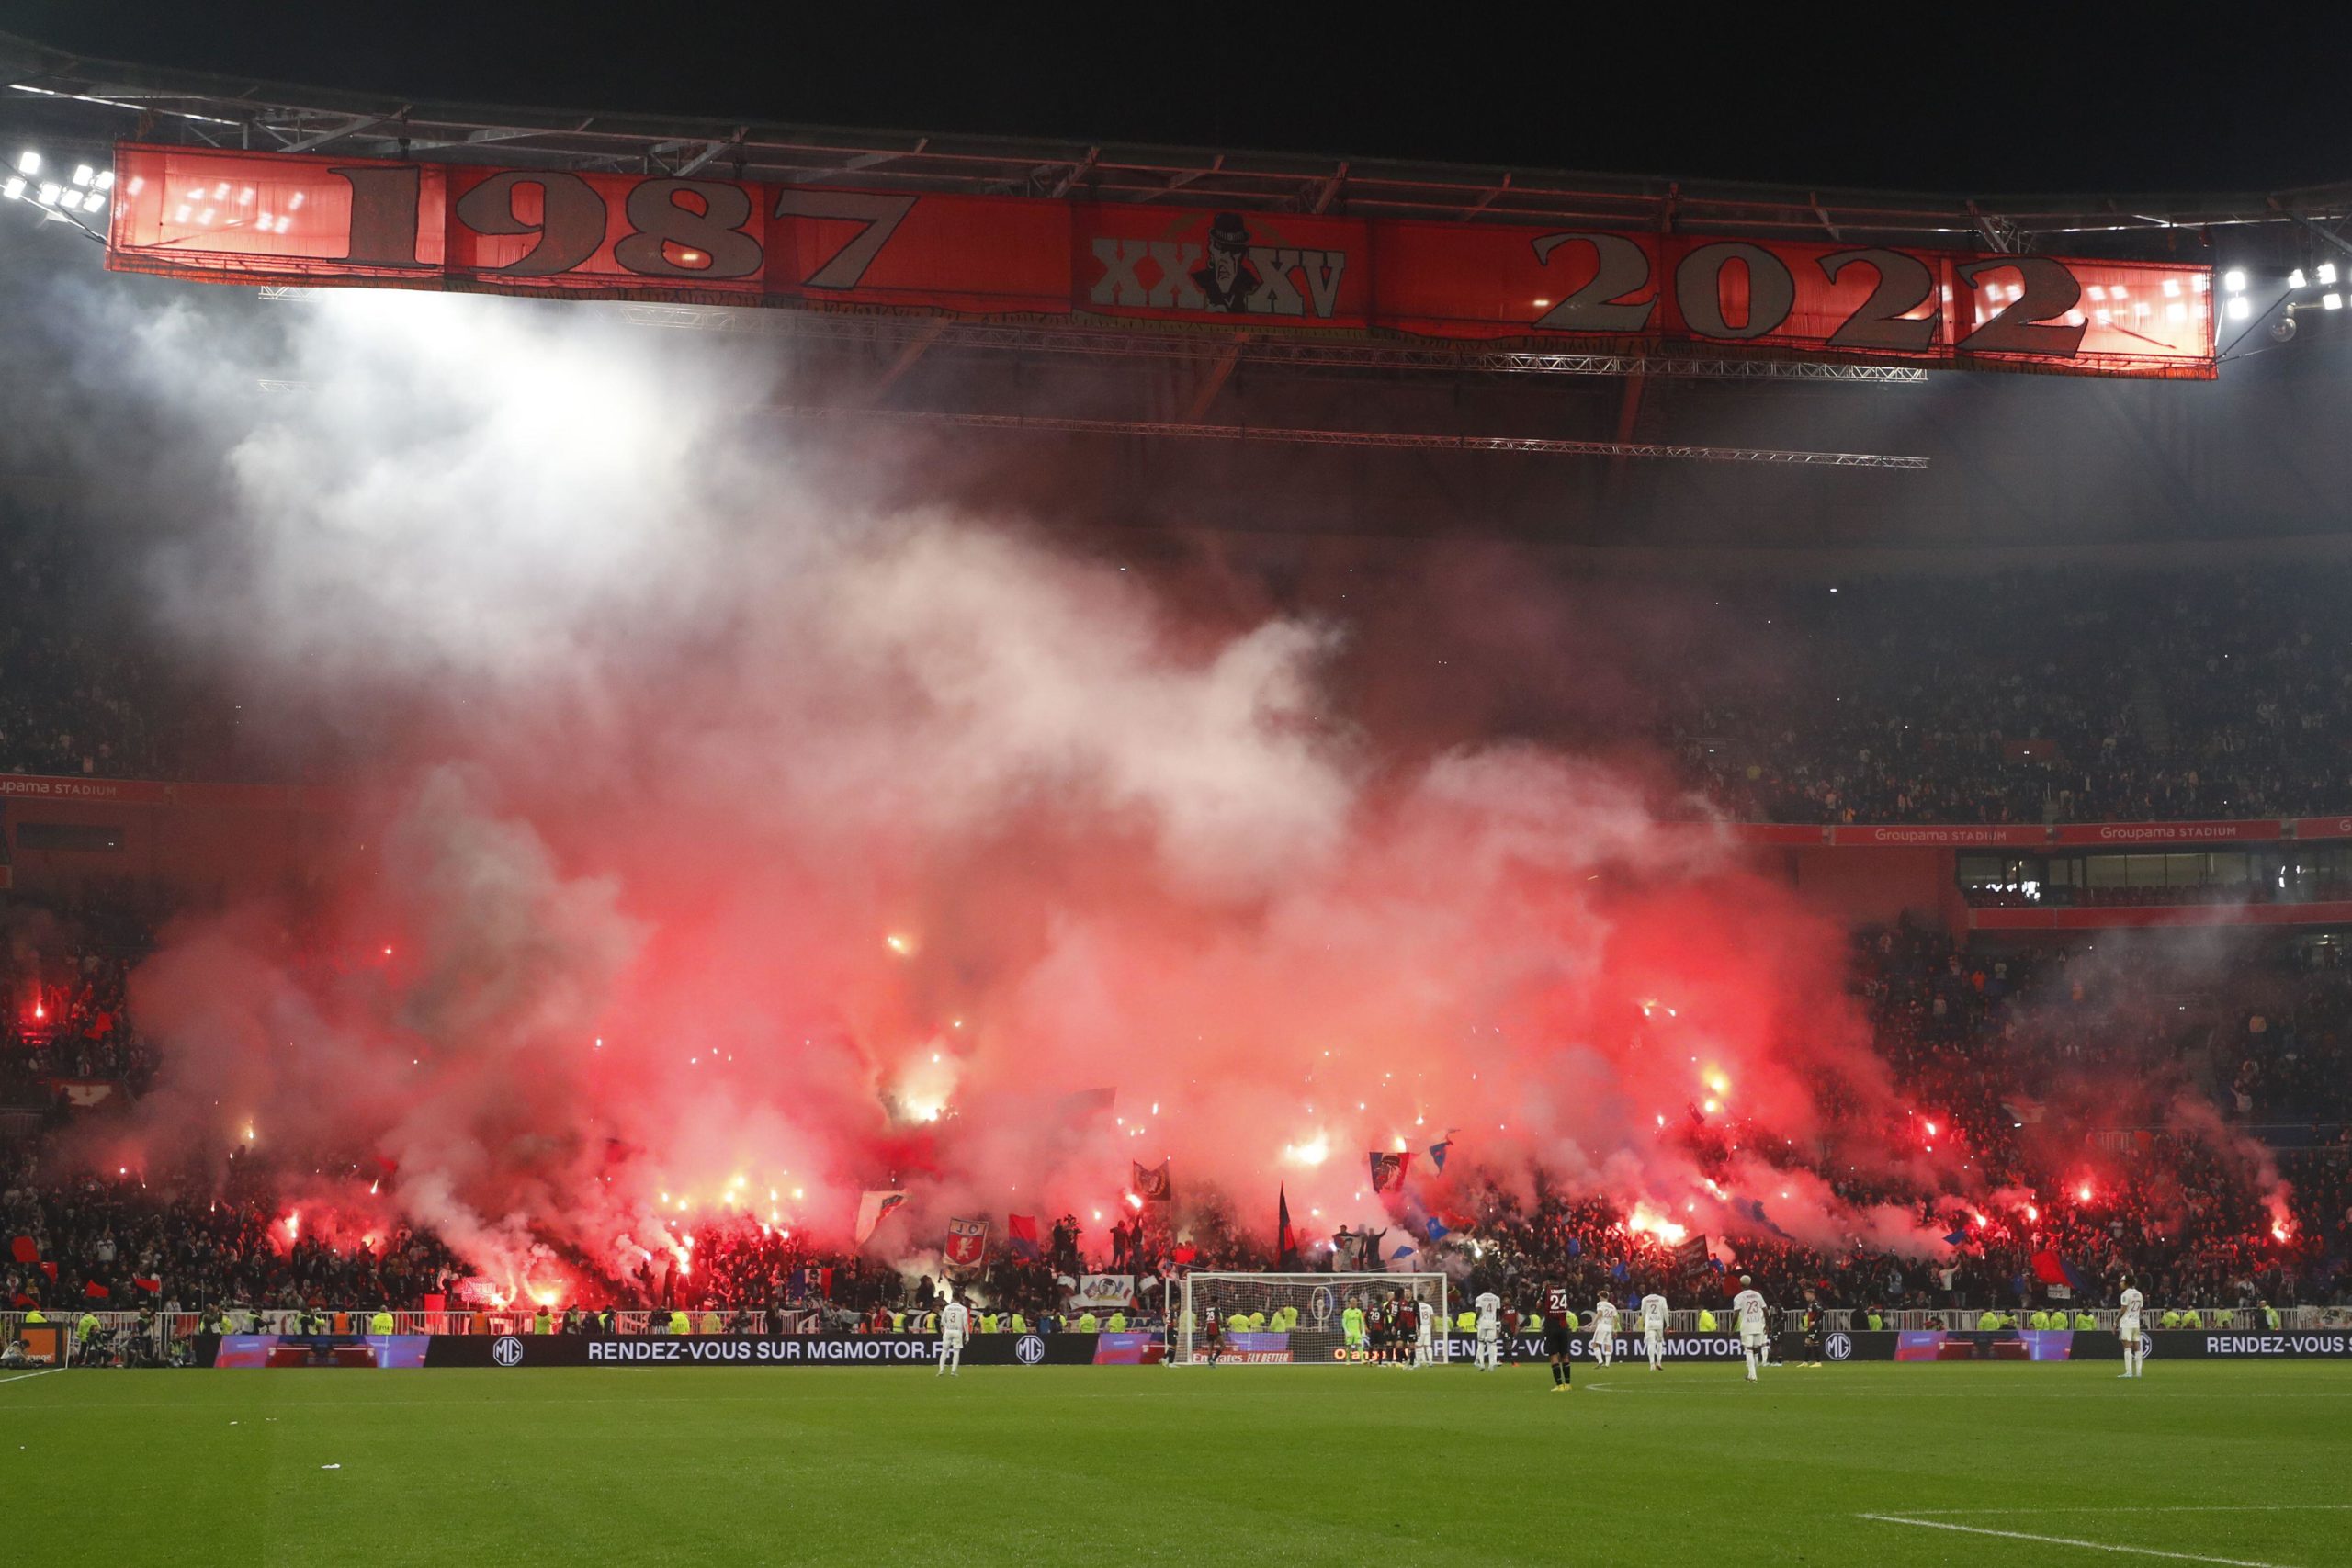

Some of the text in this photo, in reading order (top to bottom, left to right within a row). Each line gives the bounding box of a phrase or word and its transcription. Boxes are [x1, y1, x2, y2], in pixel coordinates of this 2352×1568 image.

[328, 166, 917, 290] 1987
[1530, 232, 2088, 359] 2022
[55, 784, 117, 796] STADIUM
[1875, 829, 2007, 842] Groupama STADIUM
[2101, 827, 2236, 840] Groupama STADIUM
[1486, 1303, 1492, 1313] 4
[1549, 1293, 1567, 1310] 24
[1746, 1300, 1758, 1314] 23
[2131, 1300, 2141, 1312] 27
[1650, 1303, 1657, 1314] 2
[949, 1312, 956, 1323] 3
[1370, 1311, 1380, 1321] 29
[495, 1340, 521, 1362] MG
[588, 1341, 751, 1359] RENDEZ-VOUS
[756, 1341, 801, 1359] SUR
[1018, 1338, 1042, 1361] MG
[1827, 1336, 1849, 1358] MG
[2206, 1337, 2344, 1353] RENDEZ-VOUS
[1246, 1352, 1261, 1363] FLY
